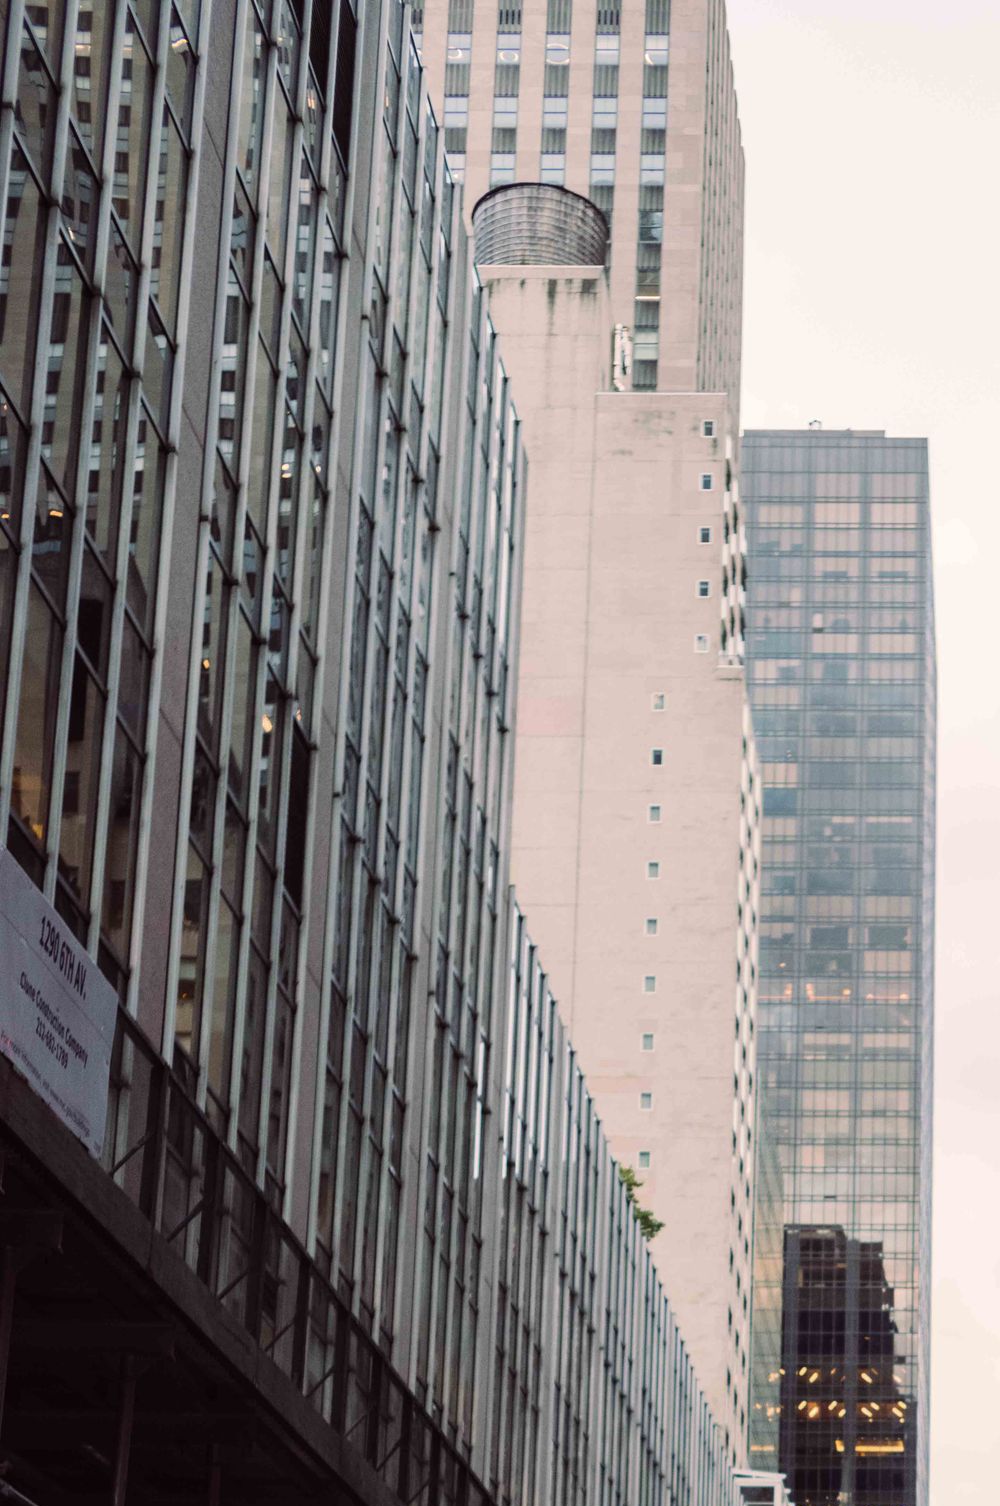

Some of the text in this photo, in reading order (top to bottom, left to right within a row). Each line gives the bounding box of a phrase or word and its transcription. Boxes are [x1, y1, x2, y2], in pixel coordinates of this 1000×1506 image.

[39, 915, 60, 964] 1290
[58, 944, 75, 985] 6TH
[65, 1028, 89, 1069] Company
